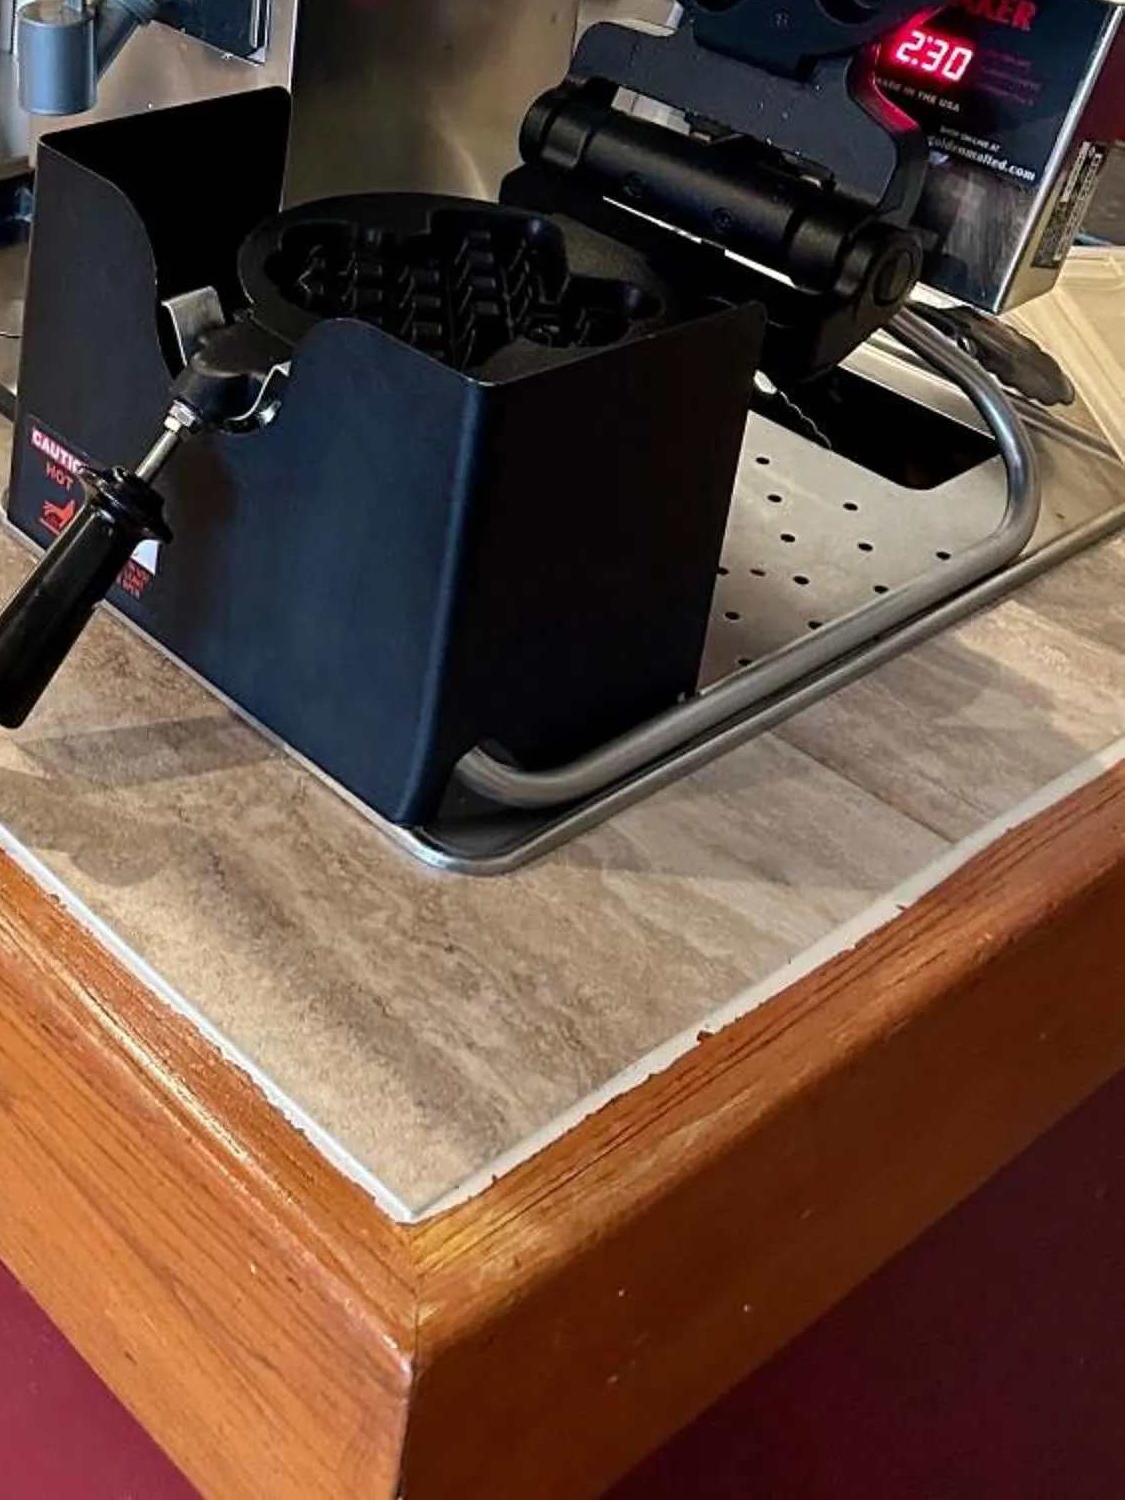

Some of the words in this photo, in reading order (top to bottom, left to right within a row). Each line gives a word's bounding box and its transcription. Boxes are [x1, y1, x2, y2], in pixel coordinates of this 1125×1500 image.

[895, 29, 974, 82] 2:30
[917, 91, 938, 106] THE
[938, 98, 960, 112] USA
[990, 143, 1001, 152] AT
[46, 461, 74, 491] HOT
